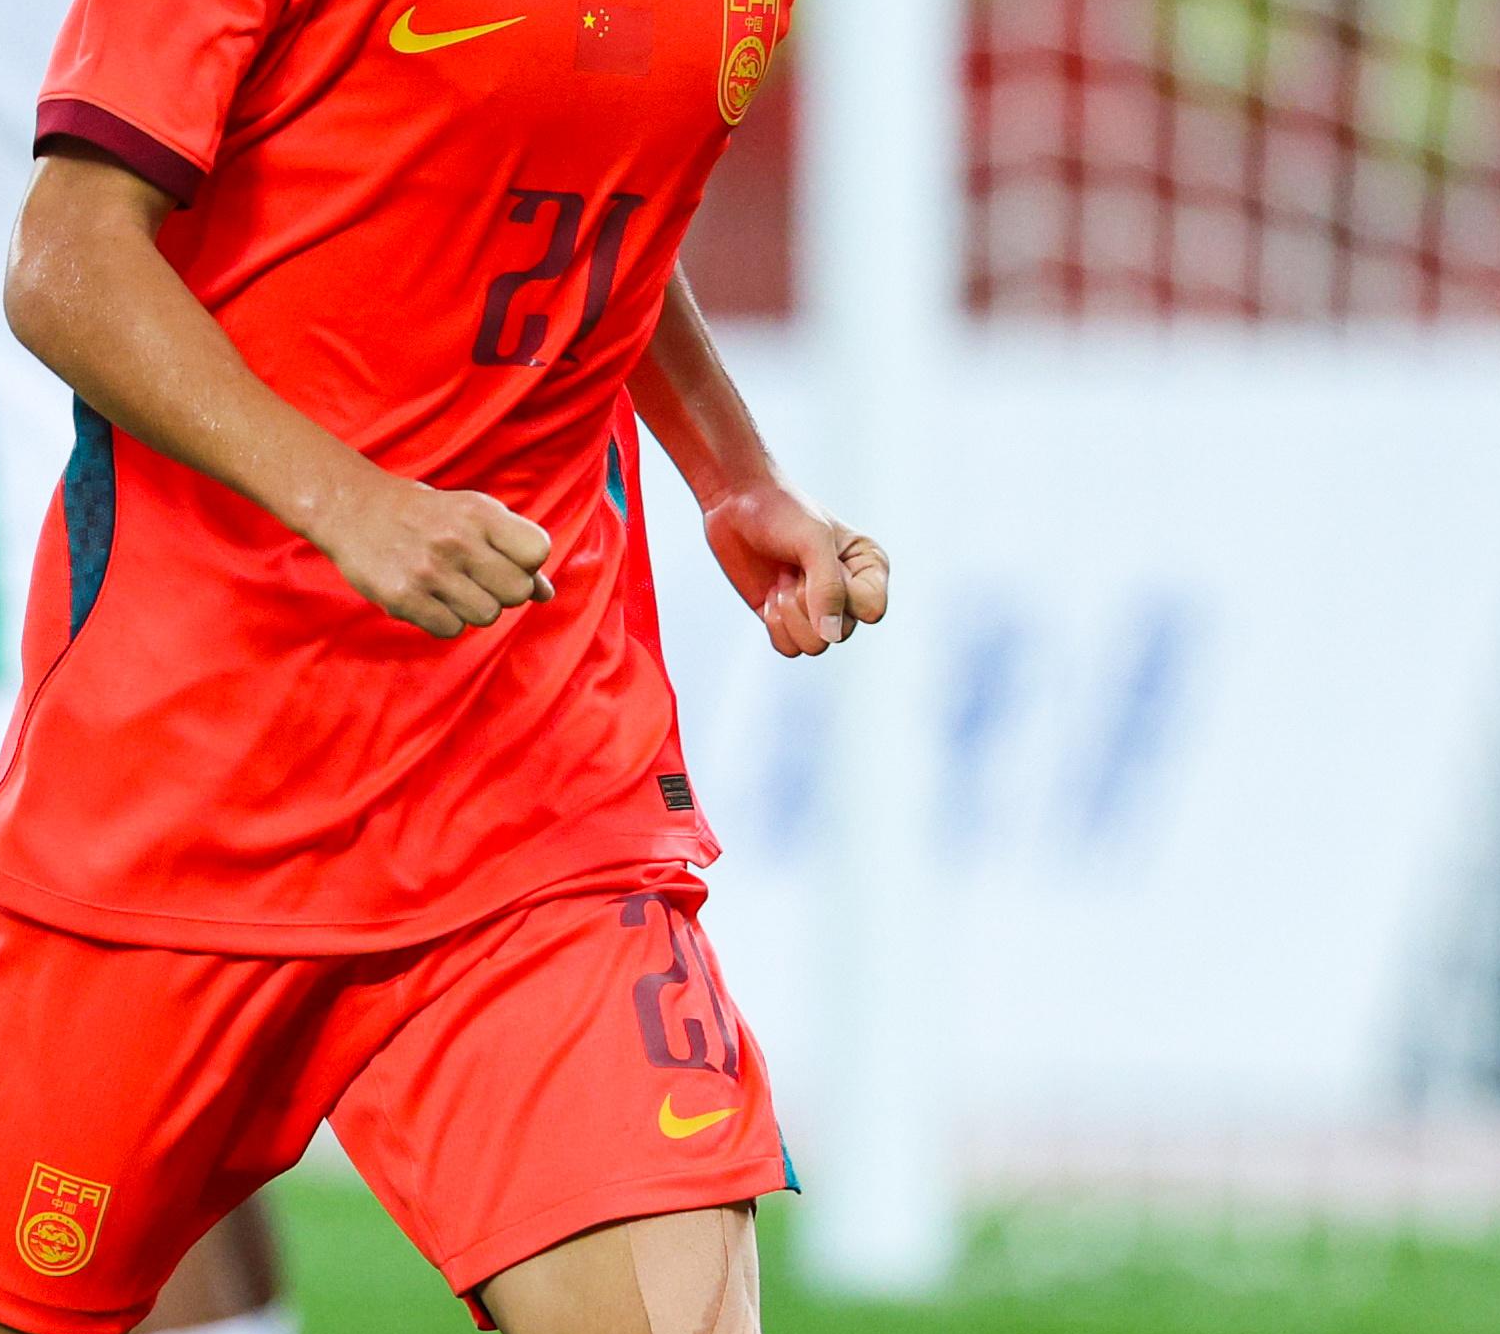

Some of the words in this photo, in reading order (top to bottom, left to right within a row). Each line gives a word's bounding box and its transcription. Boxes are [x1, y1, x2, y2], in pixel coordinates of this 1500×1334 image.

[471, 188, 646, 368] 21
[606, 891, 741, 1083] 21
[37, 1172, 101, 1207] CFA
